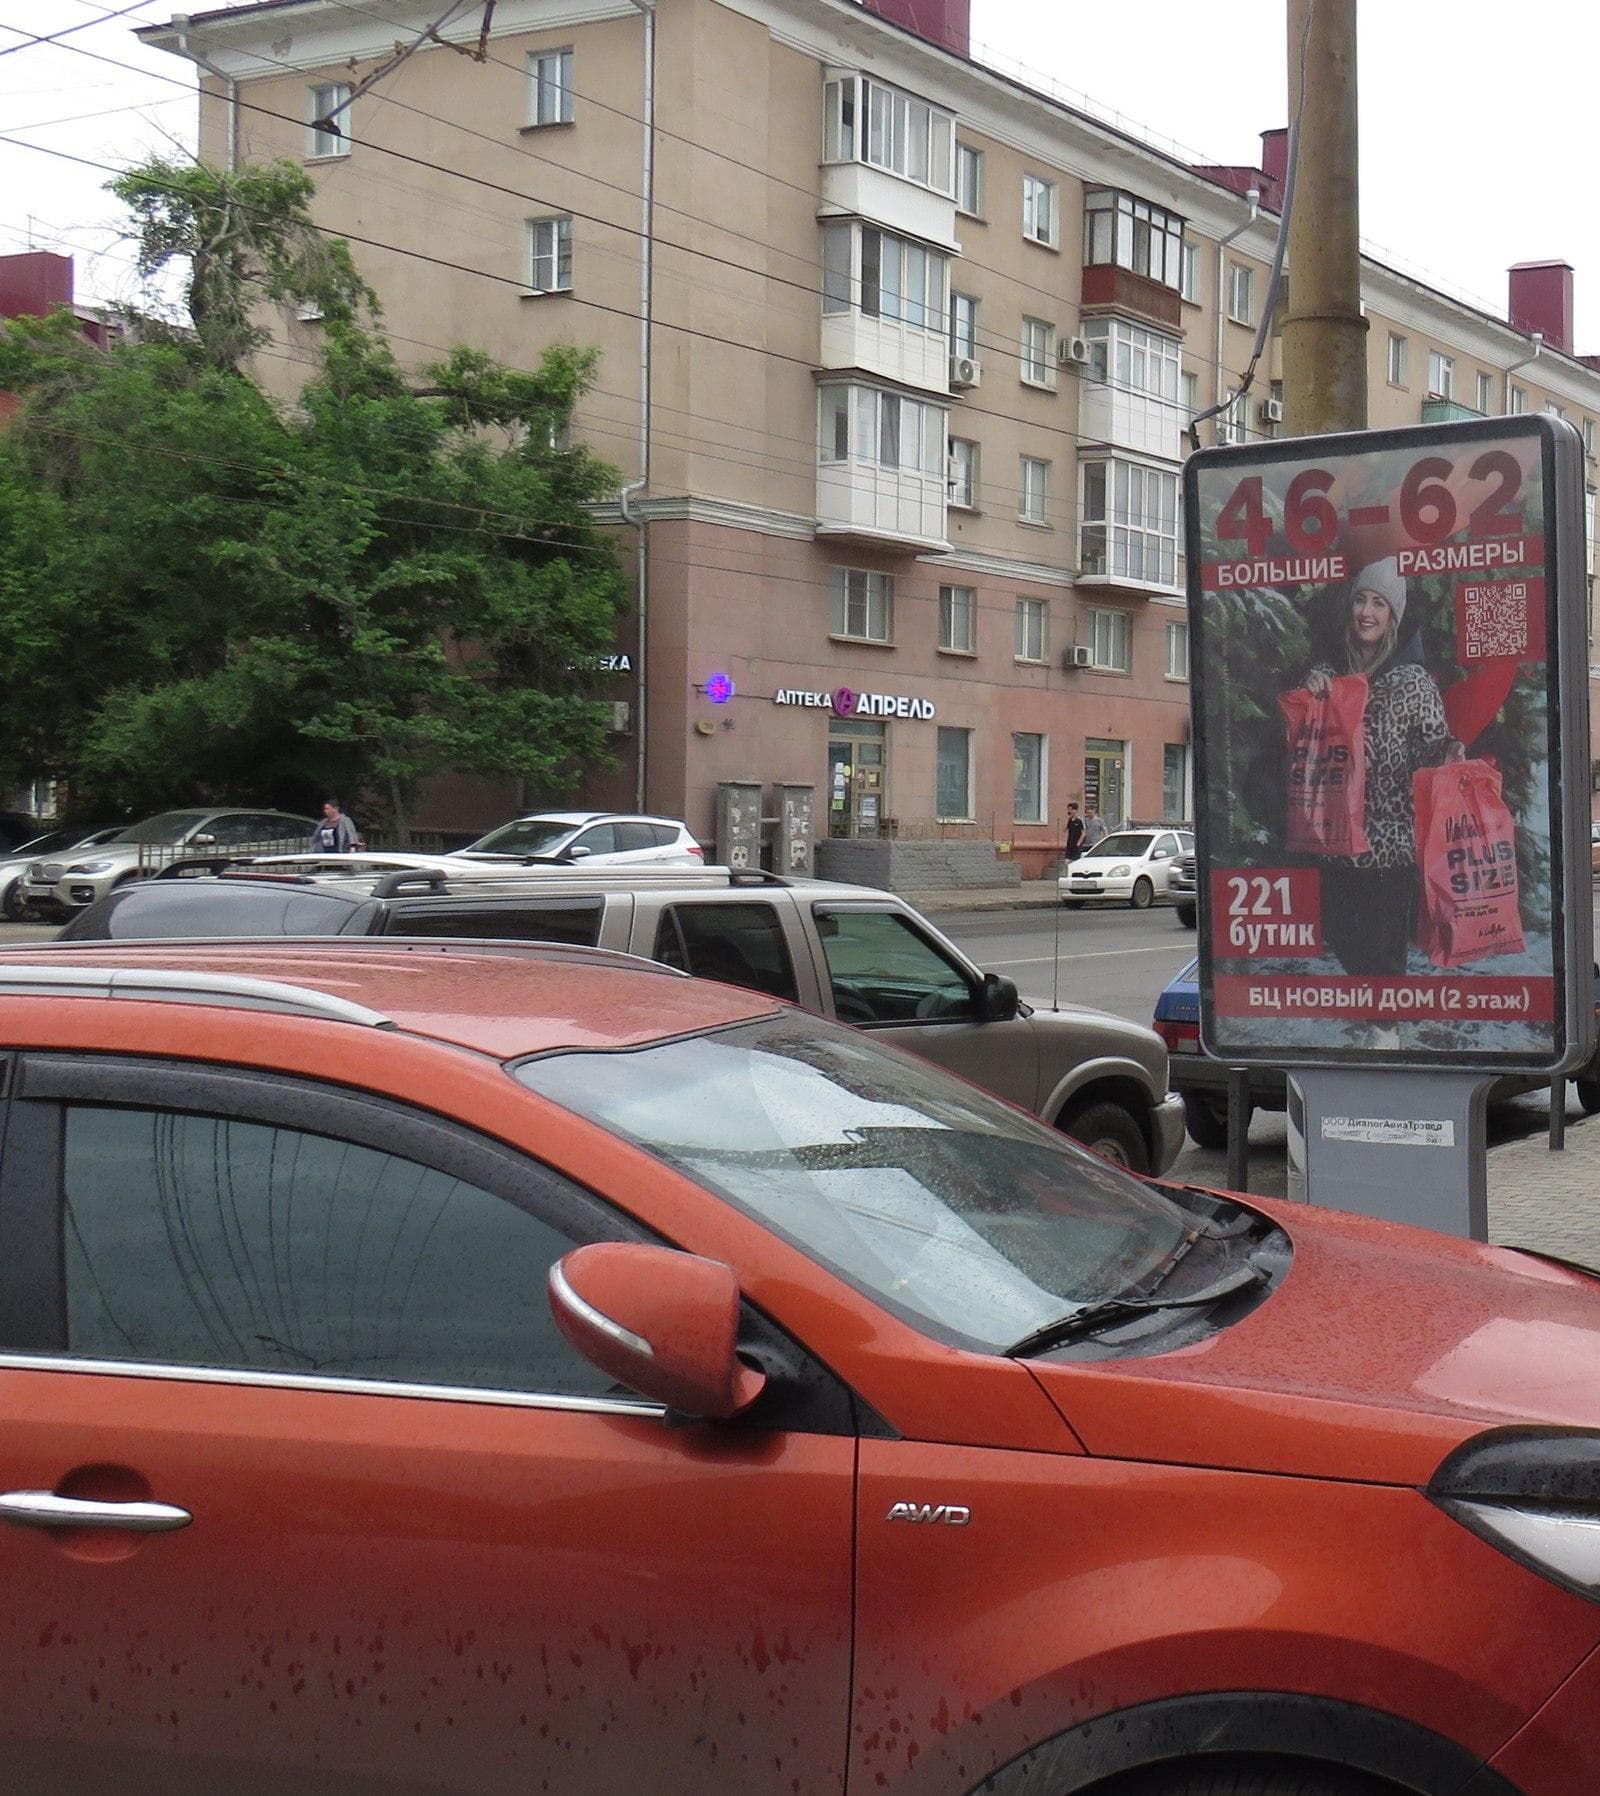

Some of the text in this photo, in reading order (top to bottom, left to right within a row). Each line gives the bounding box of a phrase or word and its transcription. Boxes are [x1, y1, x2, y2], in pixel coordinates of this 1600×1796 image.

[1215, 450, 1523, 556] 46-62
[1217, 541, 1525, 586] БОЛЬШИЕ РАЗМЕРЫ
[775, 688, 935, 719] АПТЕКА АПРЕЛЬ
[1447, 840, 1514, 870] PLUS
[1450, 864, 1515, 894] SIZE
[1227, 876, 1292, 915] 221
[1229, 918, 1315, 953] бутик
[1249, 984, 1530, 1013] БЦ НОВЫЙ ДОМ (2 этаж)
[885, 1502, 970, 1525] AWD
